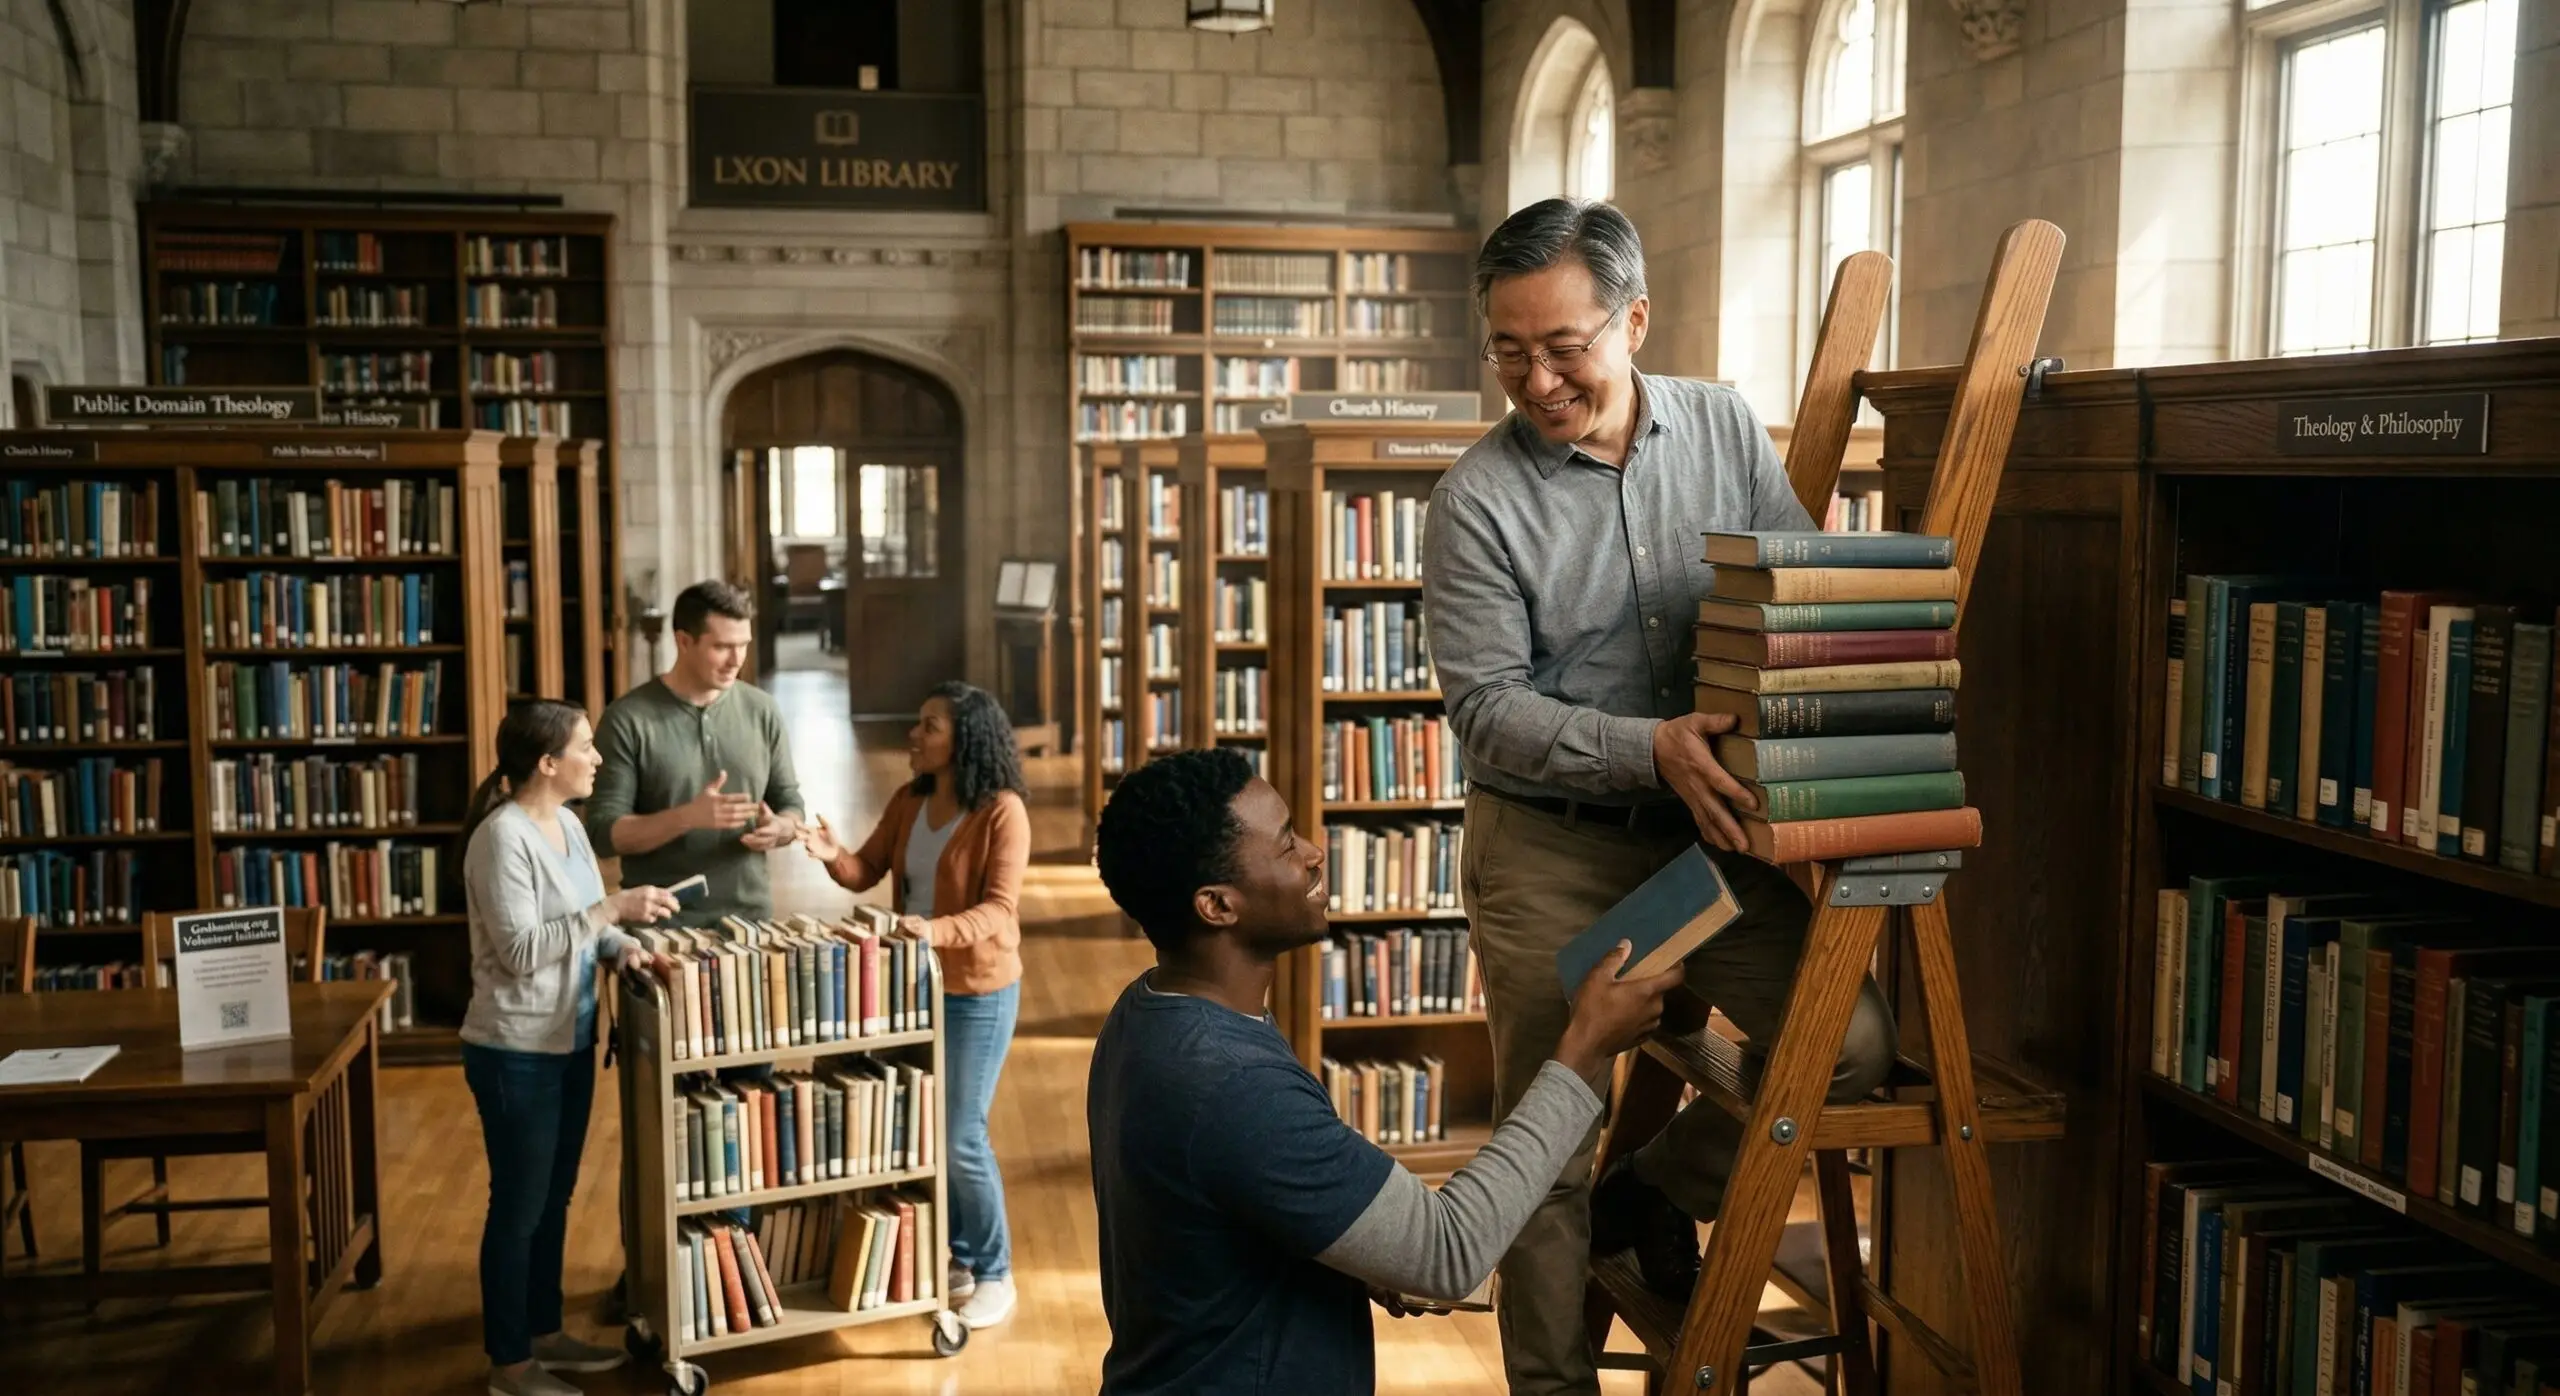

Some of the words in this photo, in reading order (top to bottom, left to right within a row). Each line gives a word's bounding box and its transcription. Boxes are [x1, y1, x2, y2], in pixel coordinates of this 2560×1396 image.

[714, 156, 808, 185] LXON
[820, 156, 959, 189] LIBRARY
[72, 394, 130, 414] Public
[135, 394, 206, 414] Domain
[211, 394, 294, 419] Theology
[344, 409, 399, 429] History
[1329, 399, 1382, 417] Church
[1385, 399, 1438, 420] History
[2293, 414, 2356, 443] Theology
[2360, 413, 2375, 435] &
[2378, 410, 2463, 441] Philosophy
